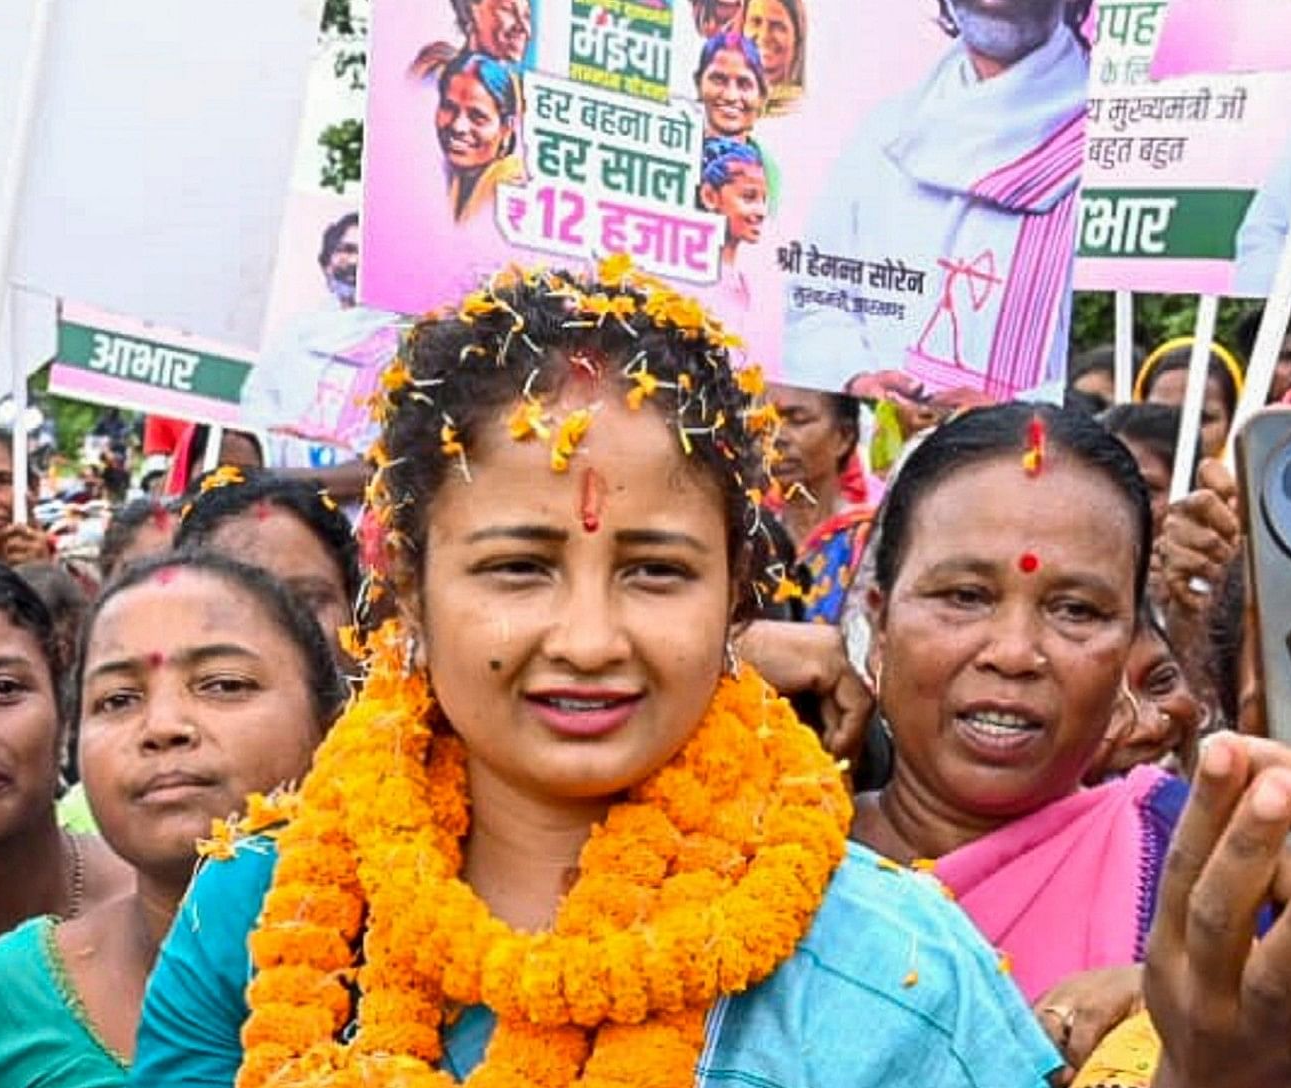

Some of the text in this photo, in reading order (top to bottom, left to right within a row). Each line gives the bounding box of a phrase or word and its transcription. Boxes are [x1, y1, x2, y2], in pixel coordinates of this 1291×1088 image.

[532, 84, 696, 154] हर बहना को
[1214, 85, 1248, 119] जी
[533, 127, 692, 206] हर साल
[536, 184, 586, 245] 12
[597, 199, 717, 272] हजार
[776, 240, 927, 295] श्री हेमन्त सोरेन
[88, 332, 201, 392] आभार
